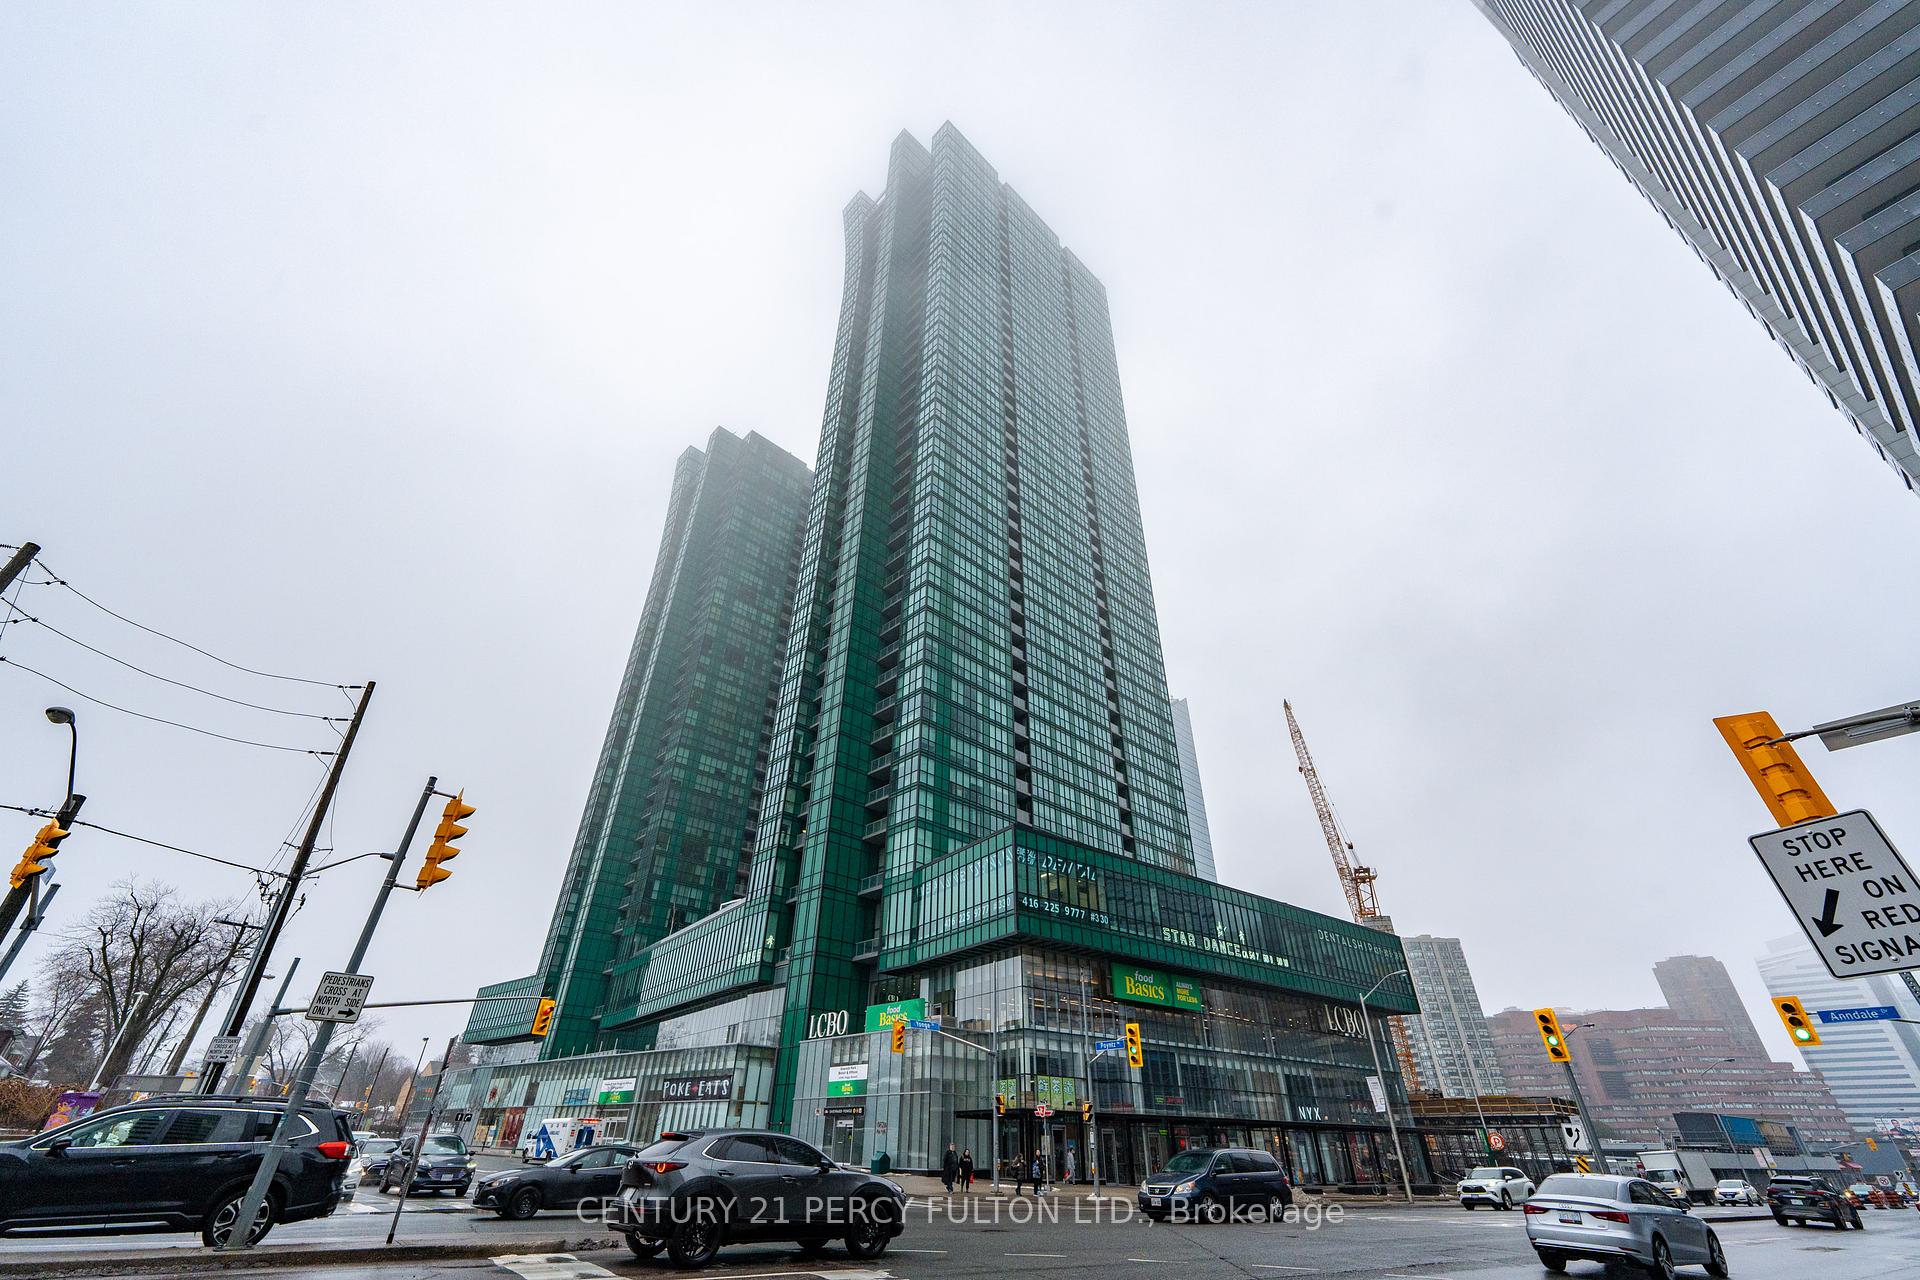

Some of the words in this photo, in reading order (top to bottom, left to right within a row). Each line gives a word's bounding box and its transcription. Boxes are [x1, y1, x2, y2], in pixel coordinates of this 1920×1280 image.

[1782, 828, 1846, 857] STOP
[1794, 852, 1873, 883] HERE
[1862, 875, 1907, 899] ON
[1022, 896, 1039, 909] 416
[1044, 901, 1060, 913] 225
[1064, 906, 1085, 920] 9777
[1091, 912, 1109, 925] #330
[1861, 903, 1920, 930] RED
[1162, 927, 1196, 948] STAR
[1203, 936, 1242, 958] DANCE
[1834, 933, 1920, 965] SIGNA
[323, 975, 371, 989] PEDESTRIANS
[1124, 975, 1165, 1001] Basics
[1134, 970, 1154, 983] food
[315, 995, 341, 1006] NORTH
[344, 998, 362, 1008] SIDE
[323, 985, 348, 997] CROSS
[351, 988, 363, 998] AT
[311, 1005, 333, 1016] ONLY
[886, 1004, 902, 1015] food
[1325, 1004, 1366, 1036] LCBO
[1829, 1009, 1879, 1021] Anndale
[808, 1009, 849, 1039] LCBO
[662, 1081, 692, 1099] POKE
[698, 1079, 729, 1097] EATS
[1298, 1106, 1322, 1120] NYX
